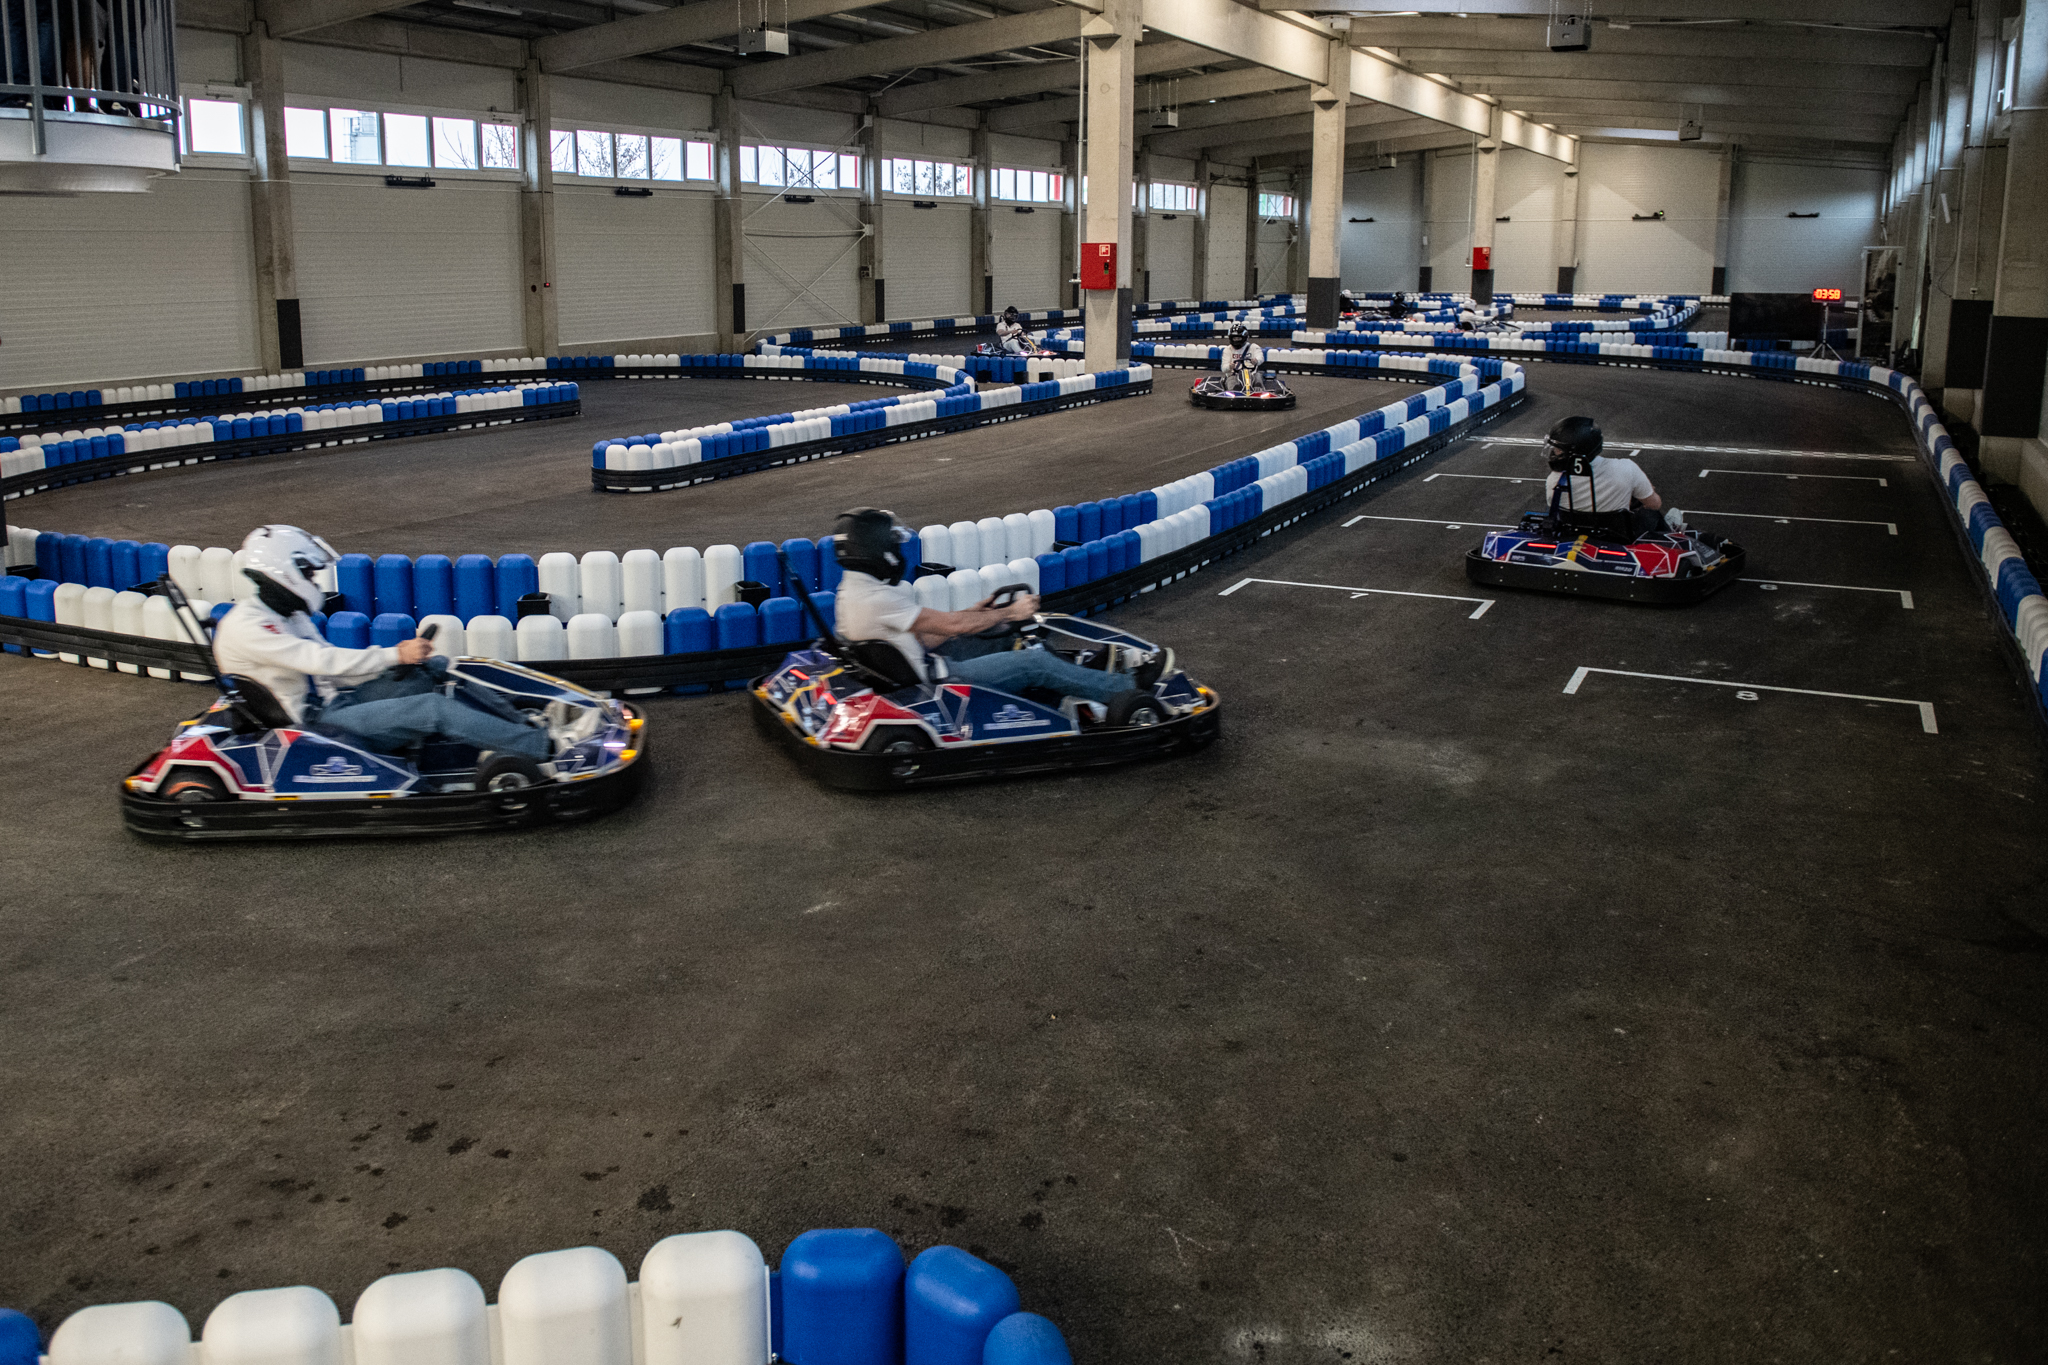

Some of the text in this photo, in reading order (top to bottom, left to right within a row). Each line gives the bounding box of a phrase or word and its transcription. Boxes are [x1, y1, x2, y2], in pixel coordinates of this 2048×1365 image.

[1574, 457, 1583, 474] 5
[1350, 591, 1369, 599] 7
[1735, 690, 1759, 701] 8
